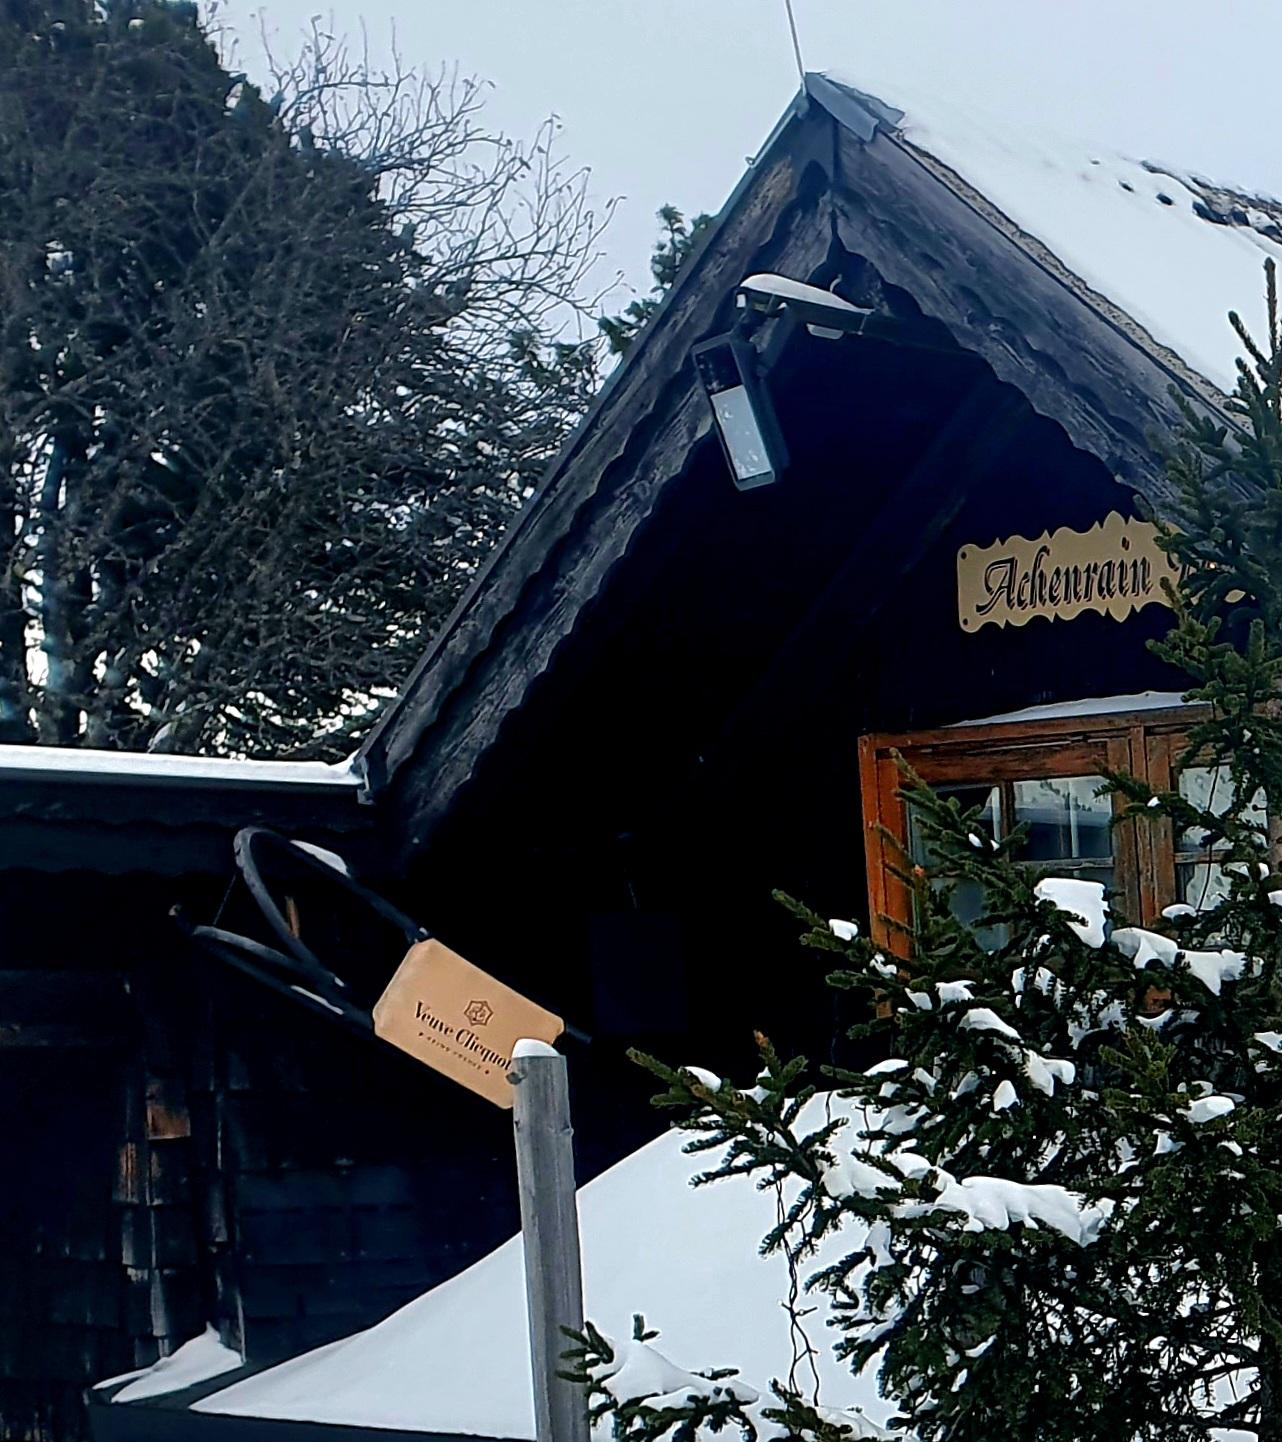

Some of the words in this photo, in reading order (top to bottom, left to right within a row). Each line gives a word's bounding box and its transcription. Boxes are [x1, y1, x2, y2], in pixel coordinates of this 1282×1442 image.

[976, 537, 1153, 616] Achenrain
[414, 1001, 454, 1035] Veuve
[455, 1028, 512, 1071] Clicquot
